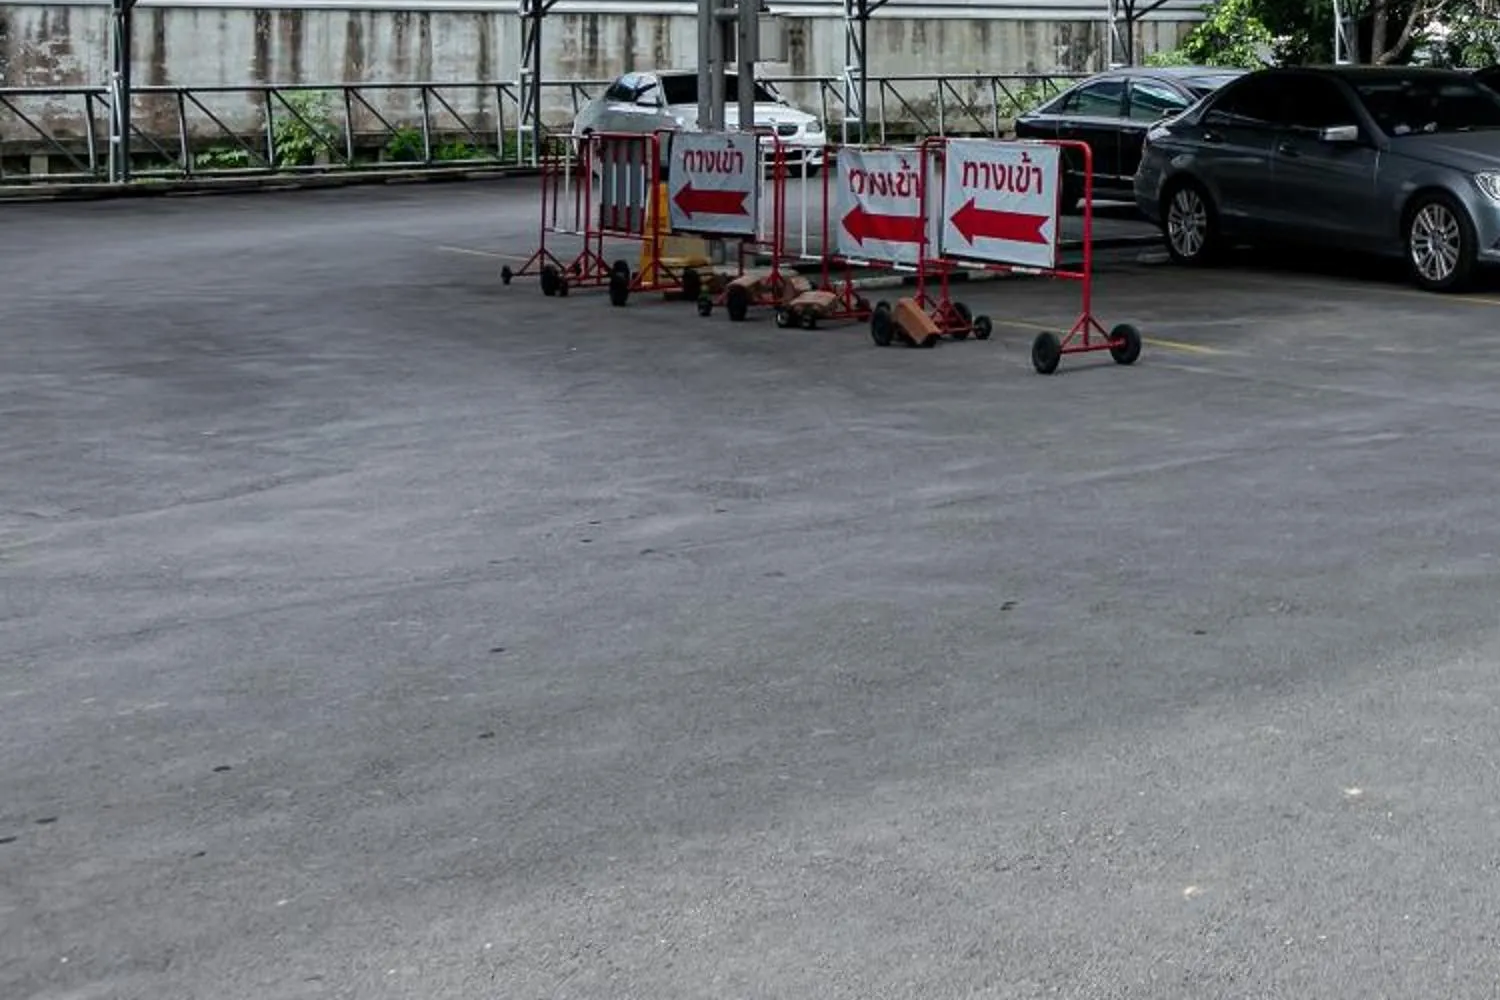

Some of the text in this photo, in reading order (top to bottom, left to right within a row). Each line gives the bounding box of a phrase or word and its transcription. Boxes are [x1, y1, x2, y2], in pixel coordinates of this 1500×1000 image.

[683, 139, 743, 173] ทางเข้า
[962, 152, 1042, 194] ทางเข้า
